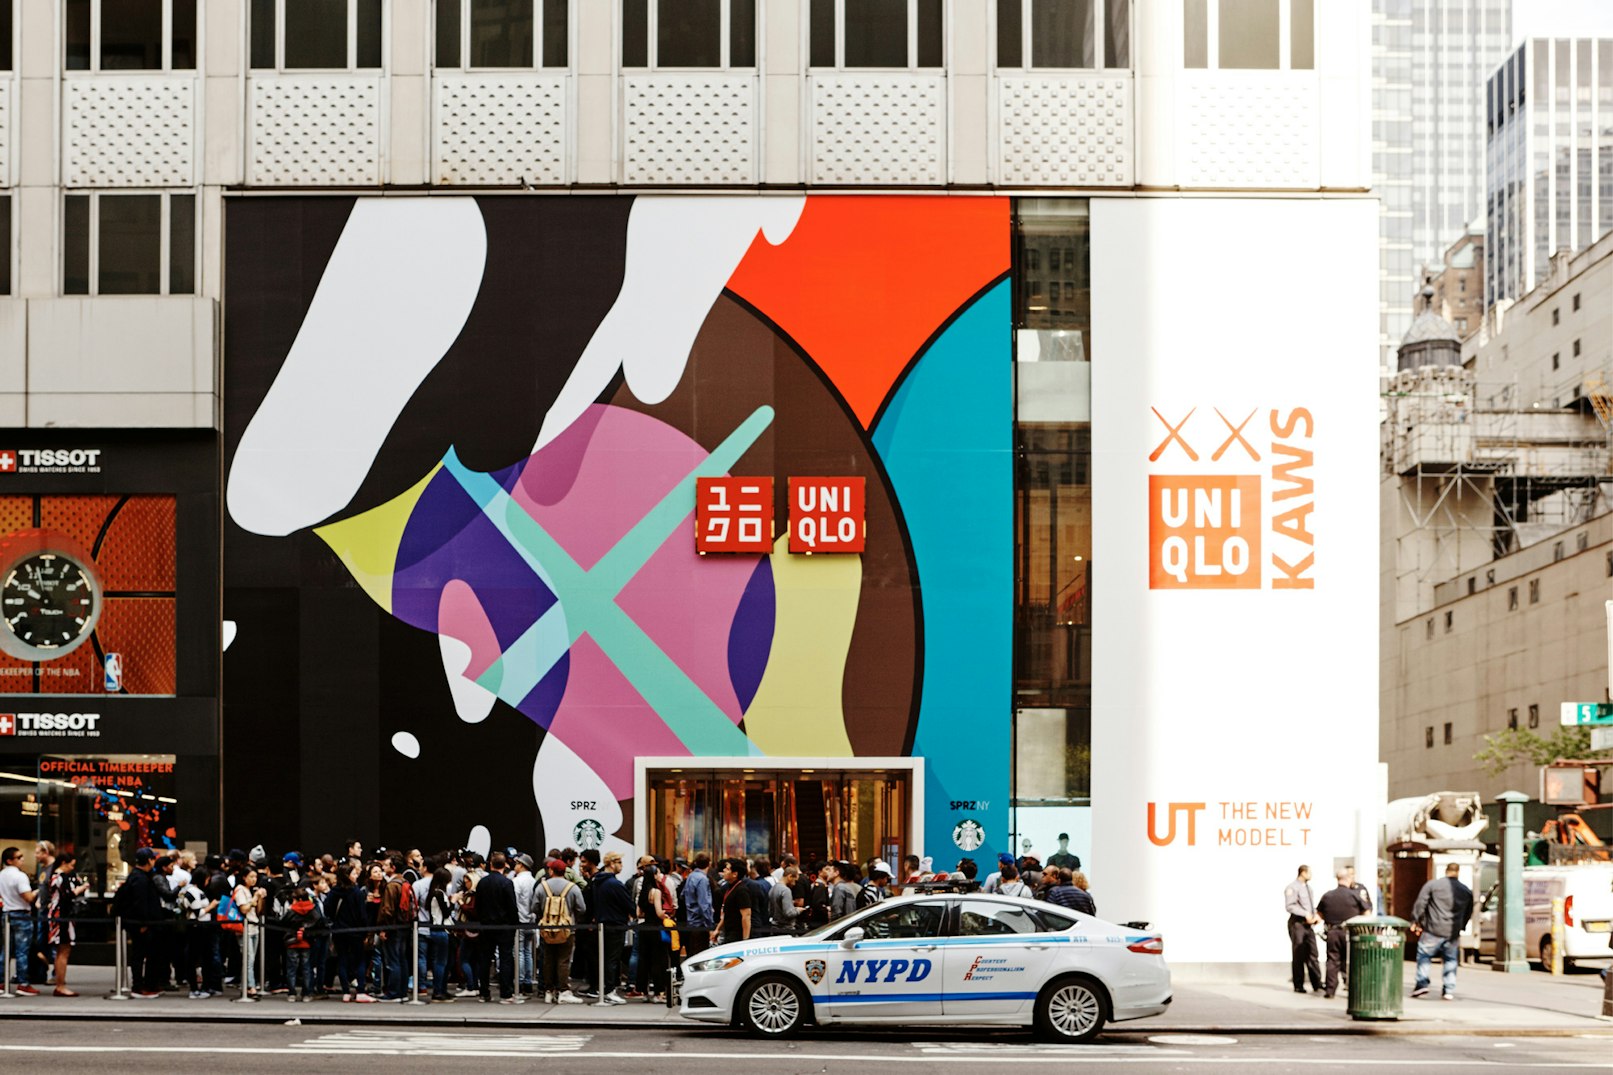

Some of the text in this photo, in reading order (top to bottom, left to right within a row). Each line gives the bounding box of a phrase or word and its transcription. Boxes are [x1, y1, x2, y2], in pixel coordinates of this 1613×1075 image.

[18, 449, 101, 466] TISSOT
[798, 486, 851, 512] UNI
[1270, 406, 1314, 589] KAWS
[1161, 488, 1241, 528] UNI
[798, 517, 856, 547] QLO
[1161, 535, 1249, 583] QLO
[35, 667, 45, 676] OF
[47, 667, 61, 676] THE
[63, 667, 80, 676] NBA
[17, 713, 100, 730] TISSOT
[1582, 705, 1591, 722] 5
[40, 761, 173, 773] OFFICIAL TIMEKEEPER
[71, 775, 143, 786] OF THE NBA
[570, 801, 597, 810] SPRZ
[1219, 802, 1313, 819] THE NEW
[1147, 802, 1206, 847] UT
[1218, 828, 1311, 846] MODEL T
[746, 946, 778, 957] POLICE
[835, 958, 932, 983] NYPD
